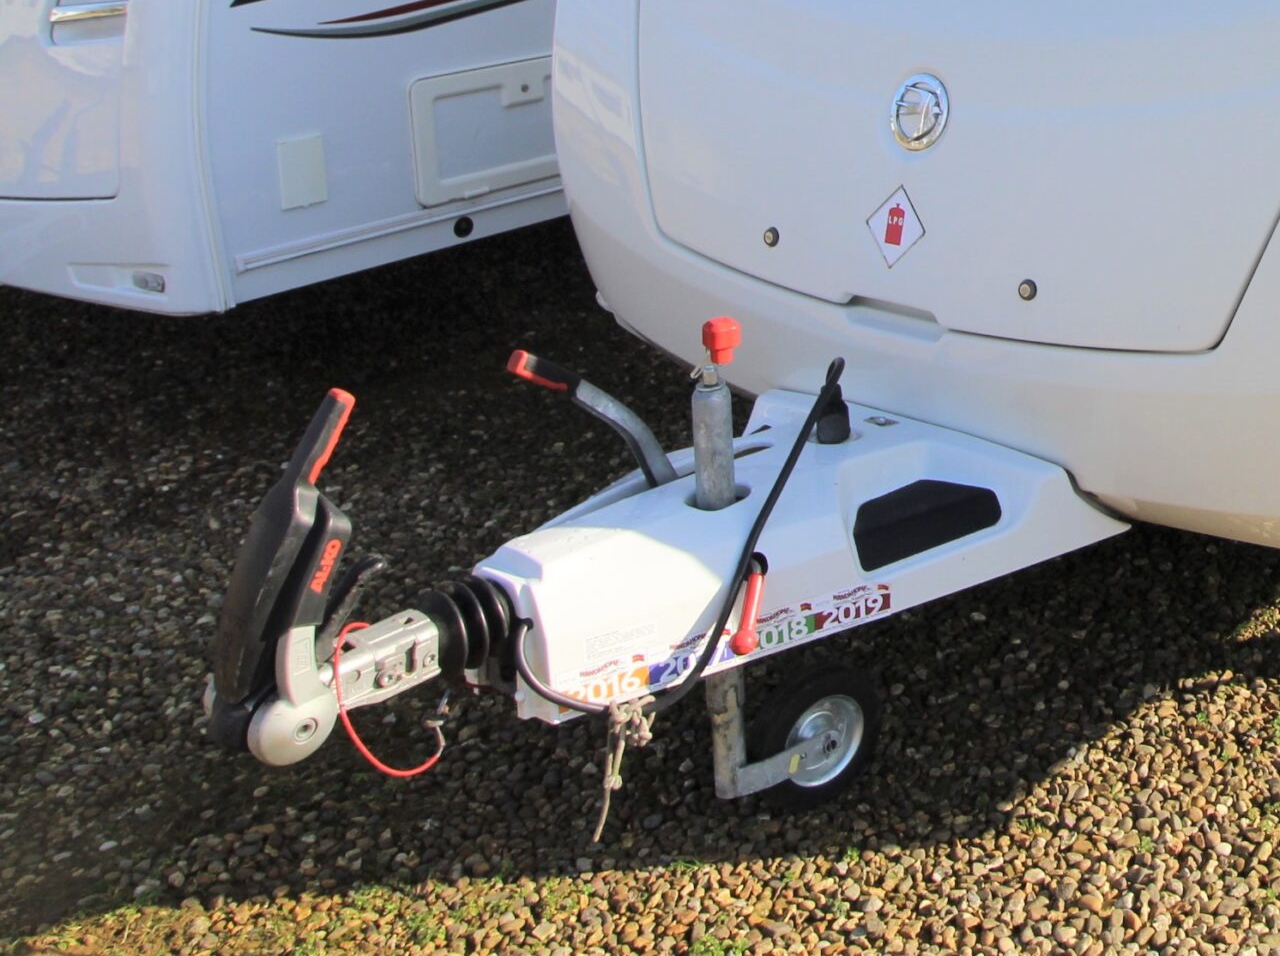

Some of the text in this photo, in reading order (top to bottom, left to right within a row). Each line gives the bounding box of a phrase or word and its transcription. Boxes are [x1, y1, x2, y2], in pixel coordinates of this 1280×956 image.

[888, 215, 904, 226] LPG
[822, 593, 884, 630] 2019
[756, 616, 809, 648] 018
